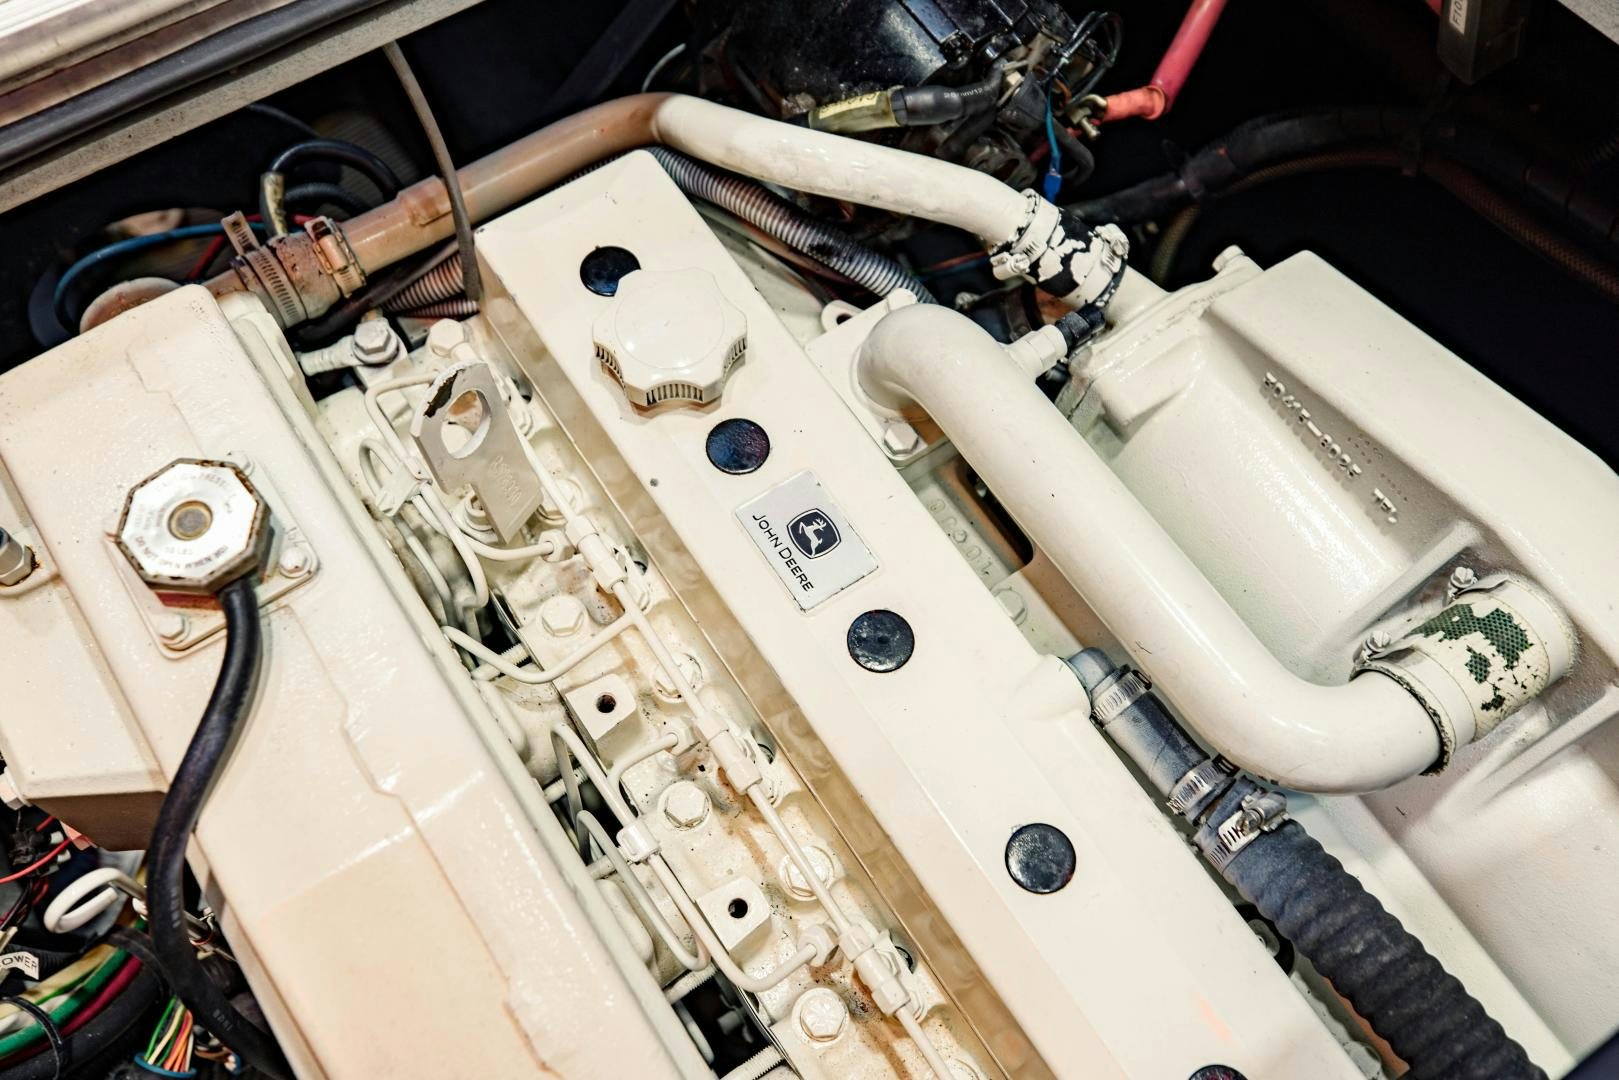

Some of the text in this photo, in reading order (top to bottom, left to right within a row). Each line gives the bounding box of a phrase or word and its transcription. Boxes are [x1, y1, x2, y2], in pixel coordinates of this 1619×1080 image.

[752, 514, 814, 592] JOHN DEERE
[0, 955, 37, 969] OWER
